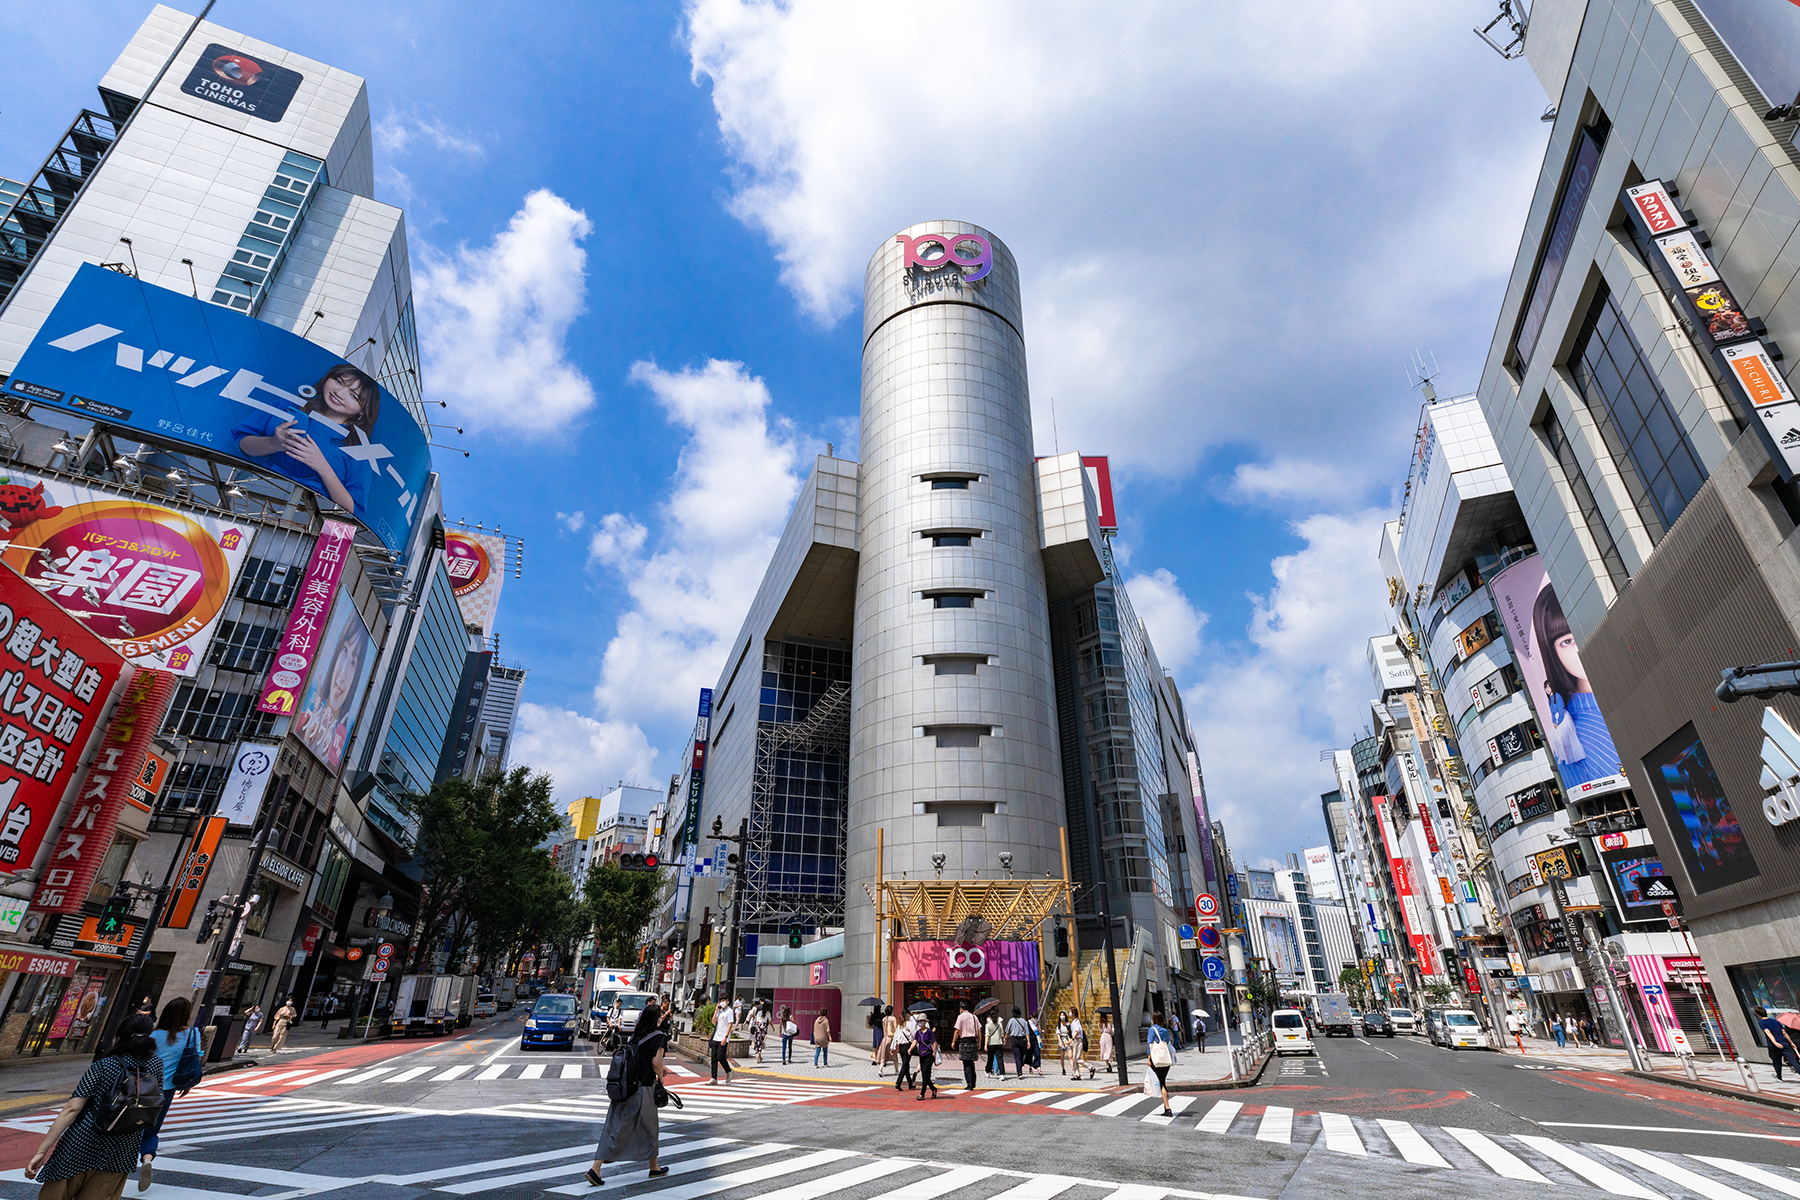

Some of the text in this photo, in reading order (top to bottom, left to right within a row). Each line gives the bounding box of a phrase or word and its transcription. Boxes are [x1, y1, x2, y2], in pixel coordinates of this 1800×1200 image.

[199, 77, 245, 100] TOHO
[194, 86, 257, 113] CINEMAS
[1630, 188, 1640, 196] 8
[1641, 195, 1669, 229] カラオケ
[1659, 238, 1667, 246] 7
[896, 233, 993, 283] 109
[902, 273, 959, 289] SHIBUYA
[1726, 348, 1736, 357] 5
[42, 387, 61, 398] Store
[87, 400, 124, 416] Google Play
[1763, 410, 1774, 419] 4
[47, 322, 419, 528] ハッピーメール
[156, 418, 215, 443] 野呂佳代
[83, 529, 182, 561] パチンコ&スロット
[224, 531, 240, 546] 40
[39, 542, 203, 617] 楽園
[287, 544, 341, 655] 品川美容外科
[171, 651, 190, 663] 30
[1516, 787, 1542, 804] ダーツバー
[1521, 802, 1548, 819] BAGUS
[1646, 888, 1674, 897] adidas
[1200, 899, 1214, 910] 30
[388, 918, 411, 937] CINEMAS
[1565, 912, 1579, 937] LOUIS
[349, 949, 360, 958] glo
[381, 946, 391, 955] 40
[0, 951, 69, 976] SLOT ESPACE
[946, 947, 986, 979] 109
[1207, 962, 1217, 978] P
